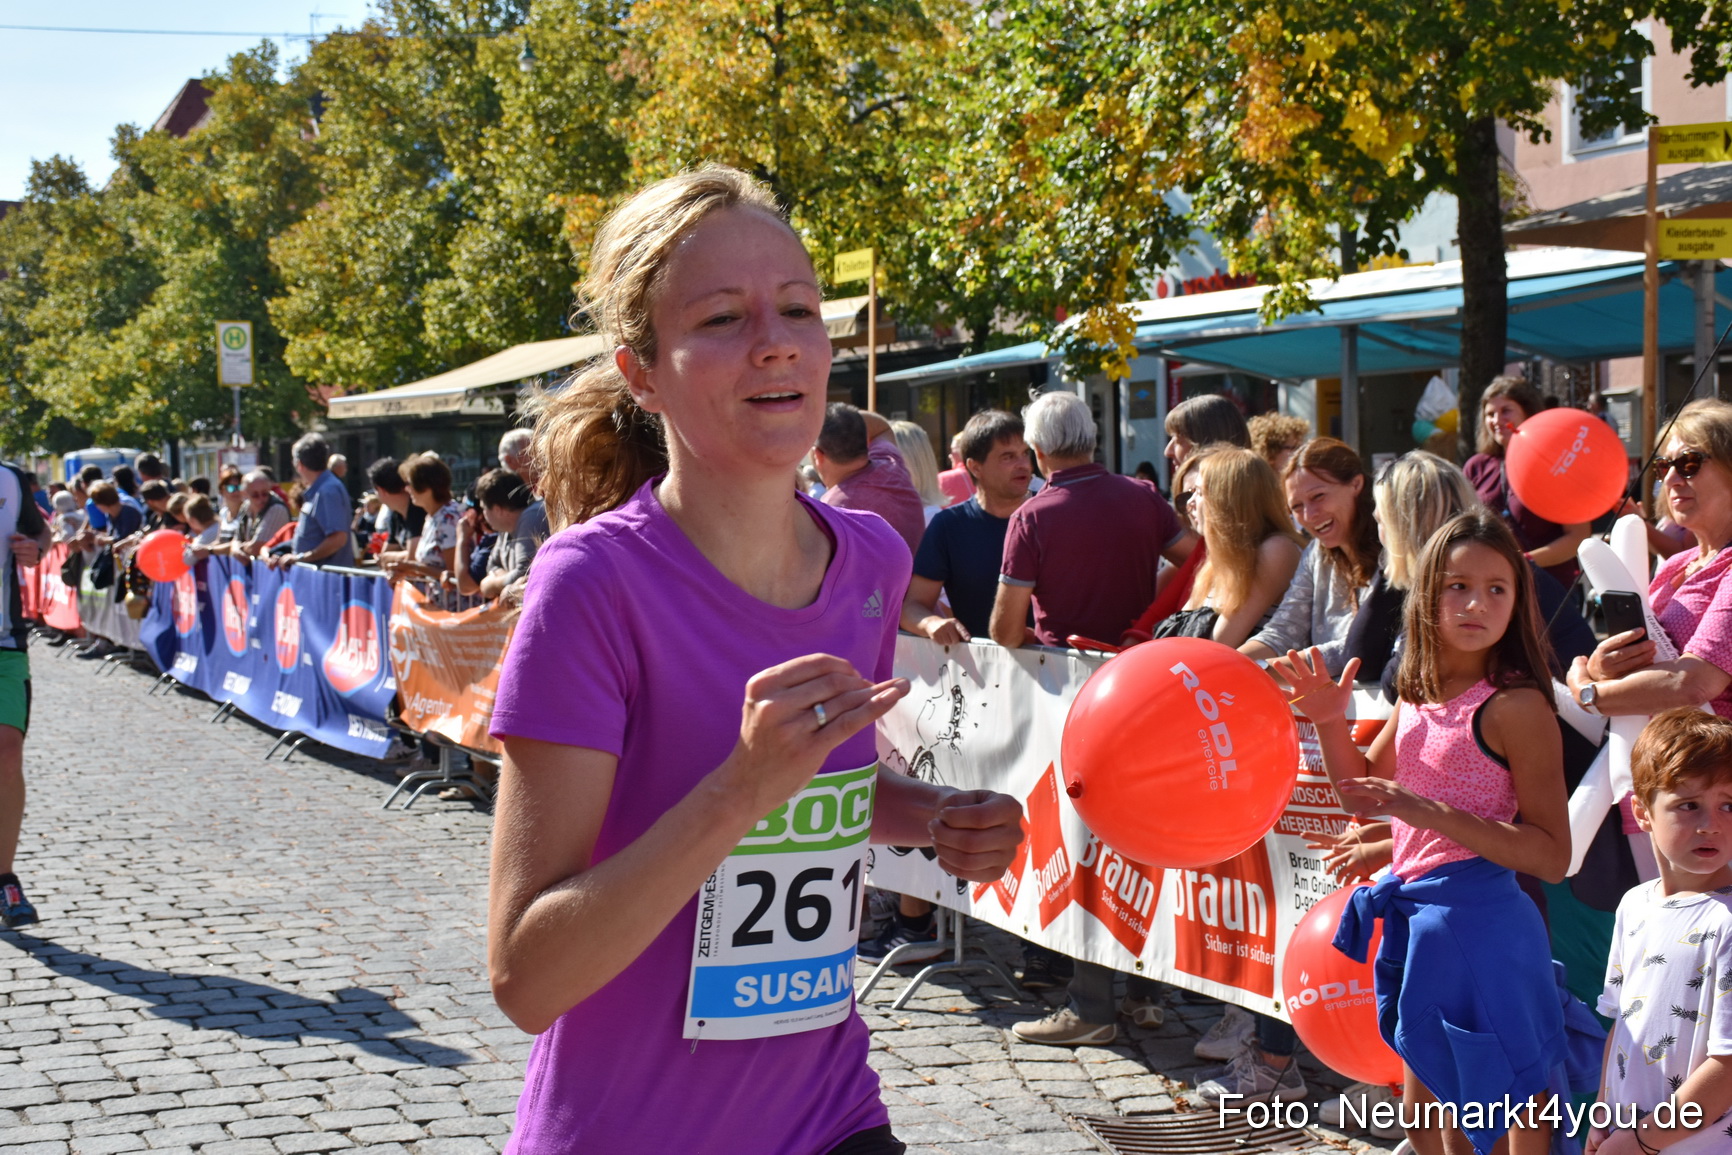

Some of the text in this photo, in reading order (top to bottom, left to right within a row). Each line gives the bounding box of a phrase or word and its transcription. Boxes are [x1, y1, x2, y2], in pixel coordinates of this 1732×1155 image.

[1667, 148, 1705, 161] ausgabe
[1665, 227, 1727, 238] Kleiderbeutel-
[1677, 242, 1714, 254] ausgabe
[842, 260, 870, 273] Toiletten
[1198, 728, 1219, 791] energie
[1033, 846, 1068, 903] Braun
[1077, 834, 1154, 918] Braun
[1289, 852, 1321, 872] Braun
[1294, 872, 1342, 896] Am Grünb
[731, 858, 861, 948] 261
[1101, 889, 1150, 939] Sicher ist sicher
[1204, 933, 1276, 966] Sicher ist sicher
[733, 956, 855, 1008] SUSAN
[1324, 991, 1375, 1012] energie
